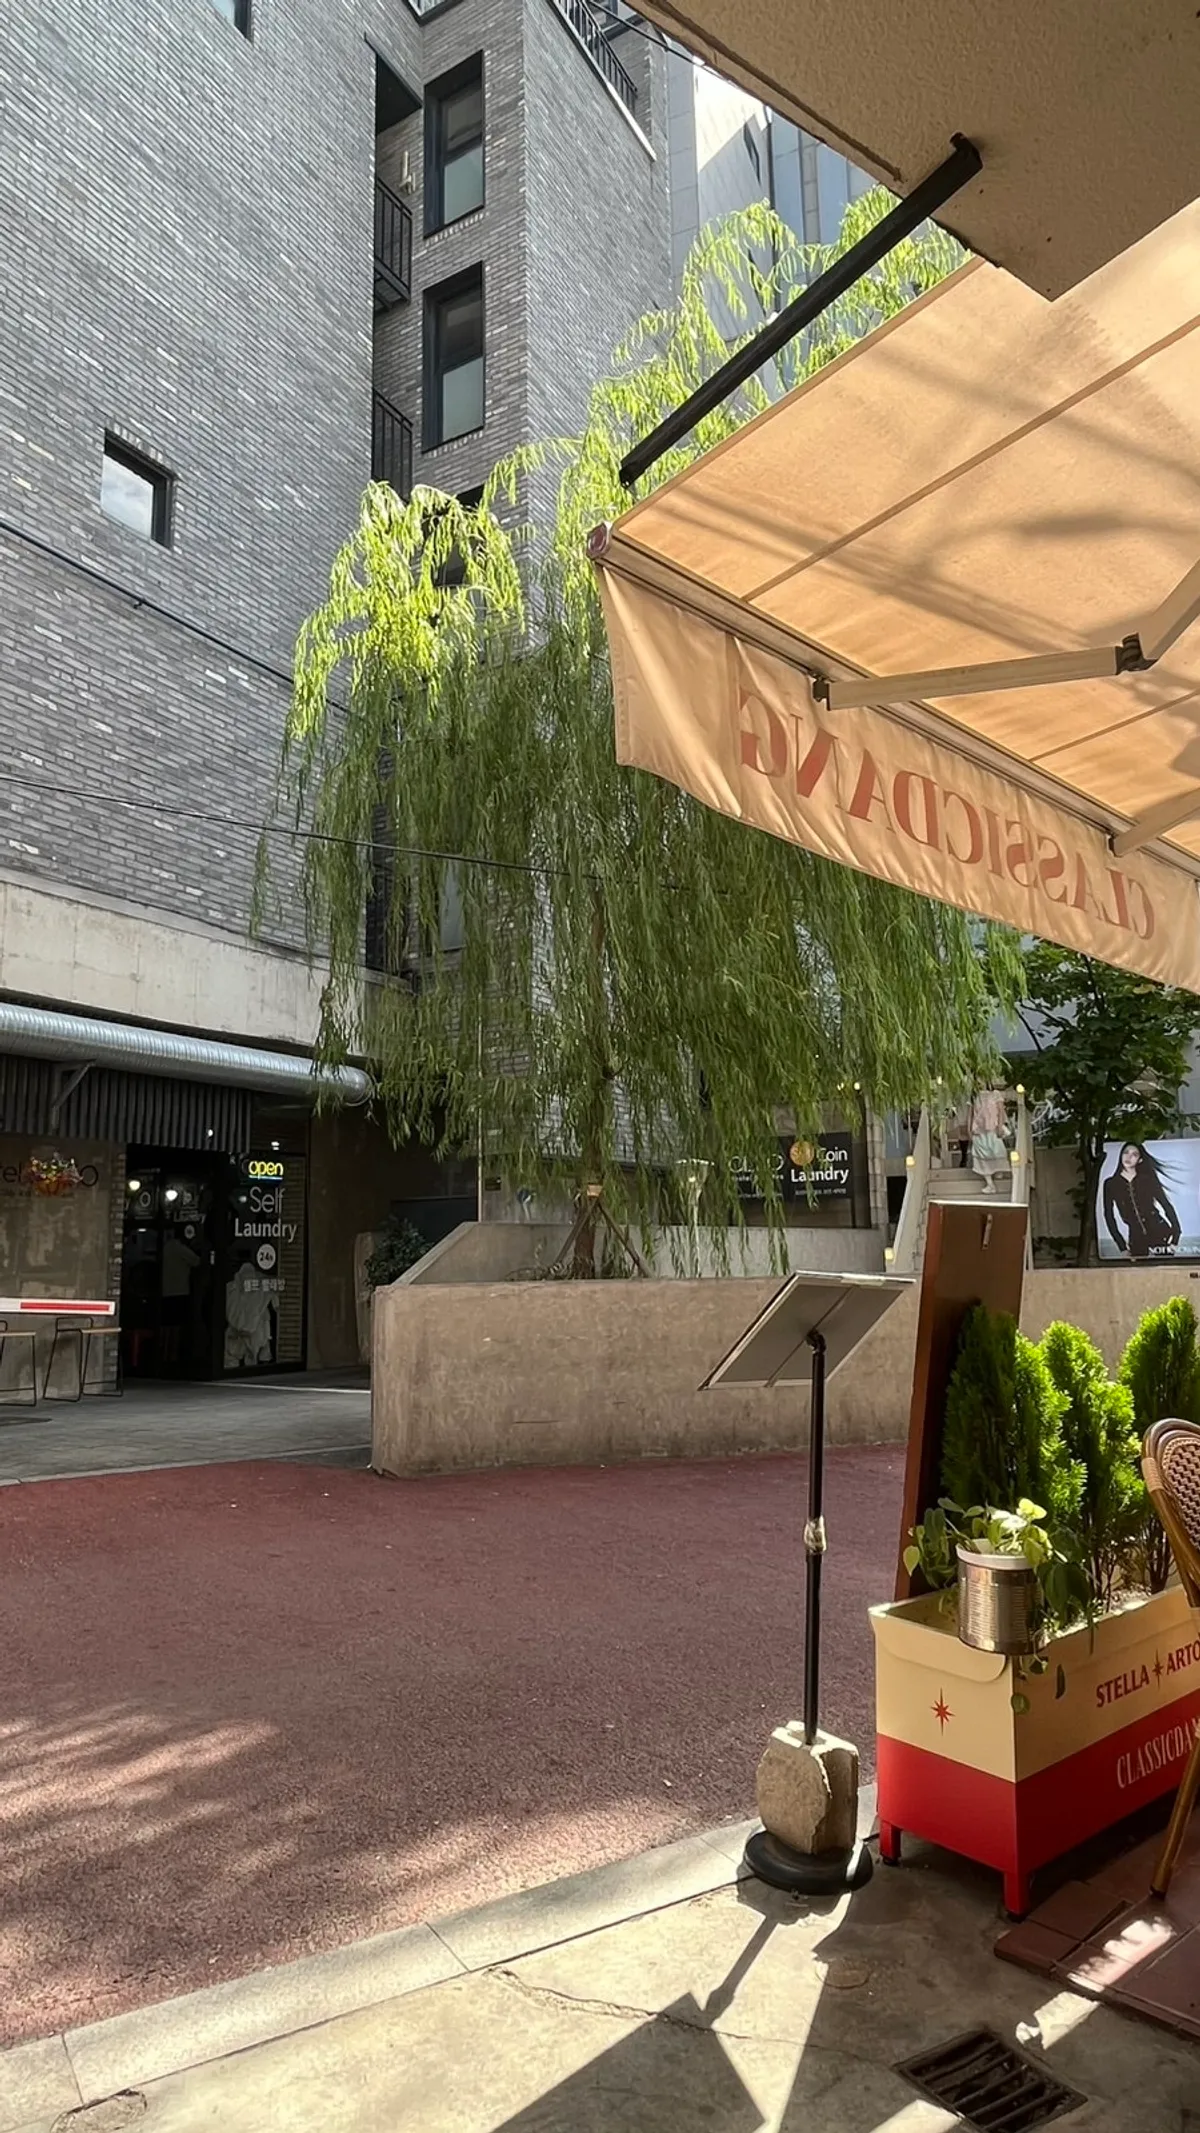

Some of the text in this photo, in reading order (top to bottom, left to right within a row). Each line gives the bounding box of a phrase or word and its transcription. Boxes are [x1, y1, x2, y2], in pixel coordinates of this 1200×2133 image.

[816, 1147, 848, 1162] Coin
[248, 1161, 284, 1180] open
[790, 1165, 850, 1184] Laundry
[249, 1186, 285, 1213] Self
[235, 1218, 297, 1243] Laundry
[1096, 1664, 1150, 1708] STELLA
